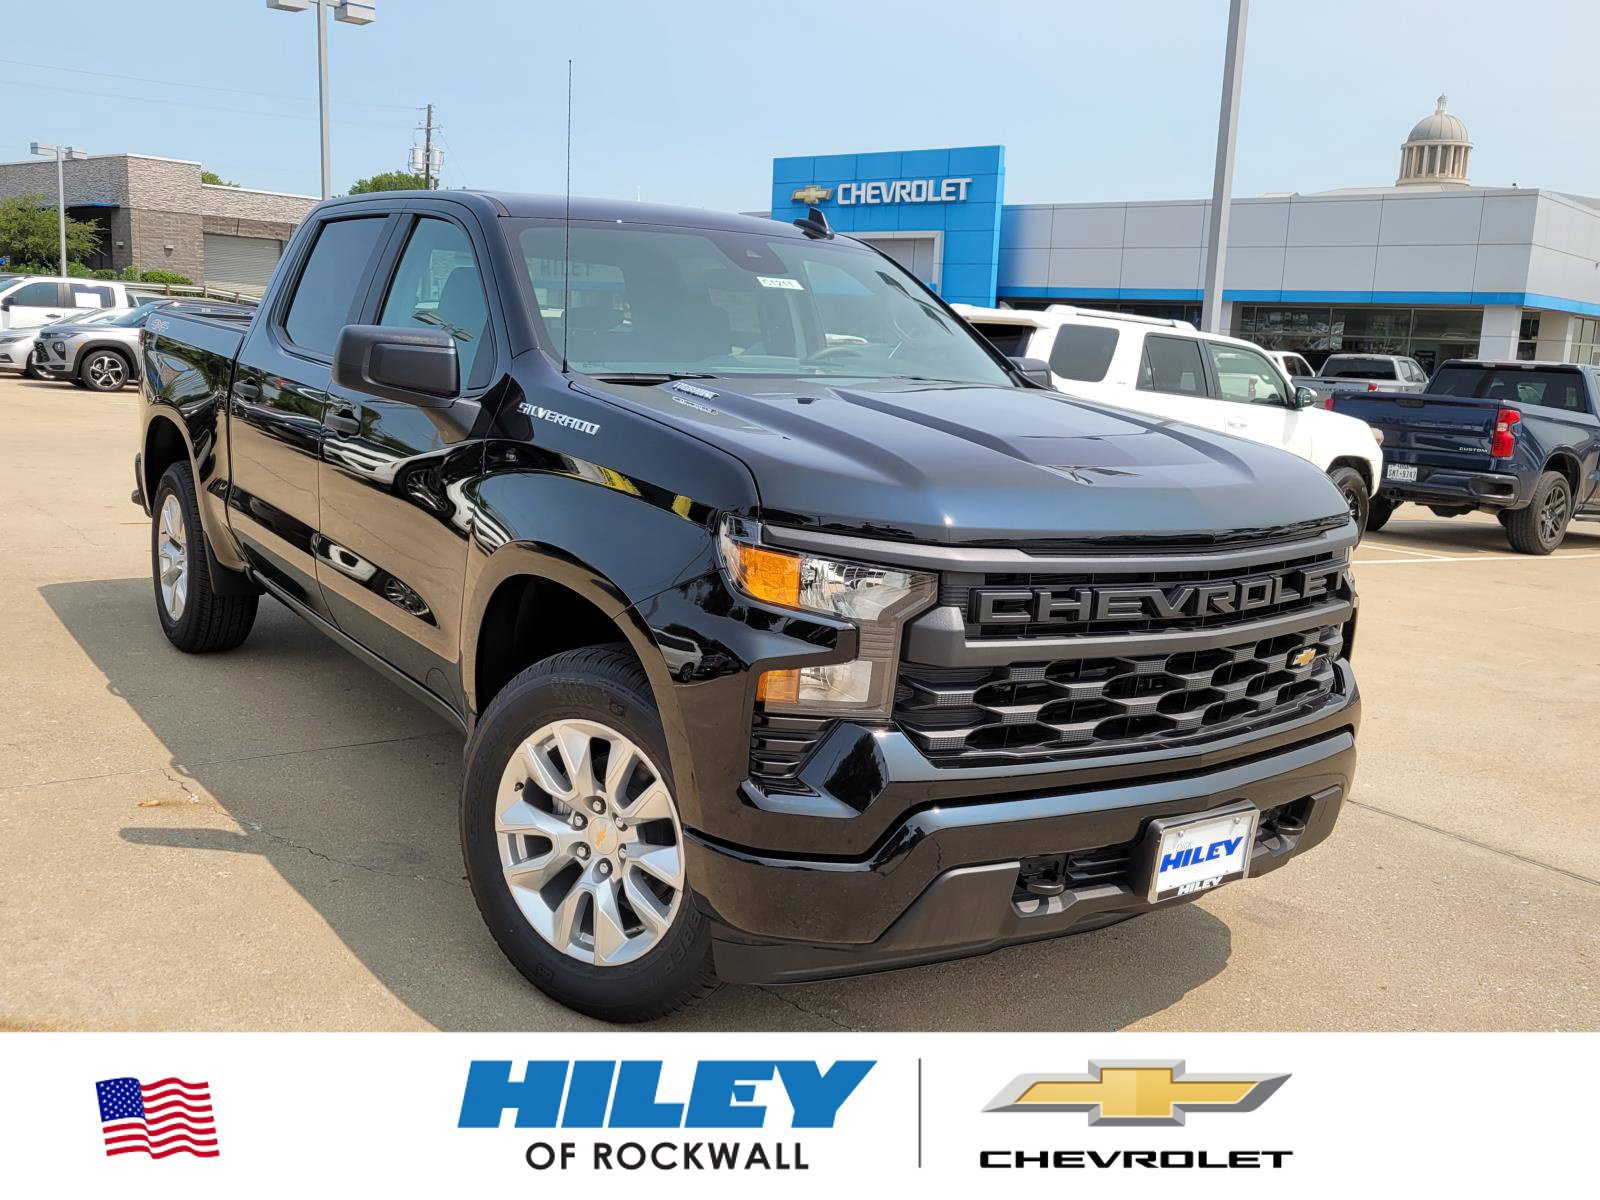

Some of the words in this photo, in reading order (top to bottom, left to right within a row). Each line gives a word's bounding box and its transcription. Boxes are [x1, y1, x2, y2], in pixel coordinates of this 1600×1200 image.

[837, 178, 973, 205] CHEVROLET
[517, 402, 600, 435] SILVERADO
[976, 562, 1351, 625] CHEVROLET
[1159, 836, 1244, 873] HILEY
[1177, 875, 1224, 896] HILEY
